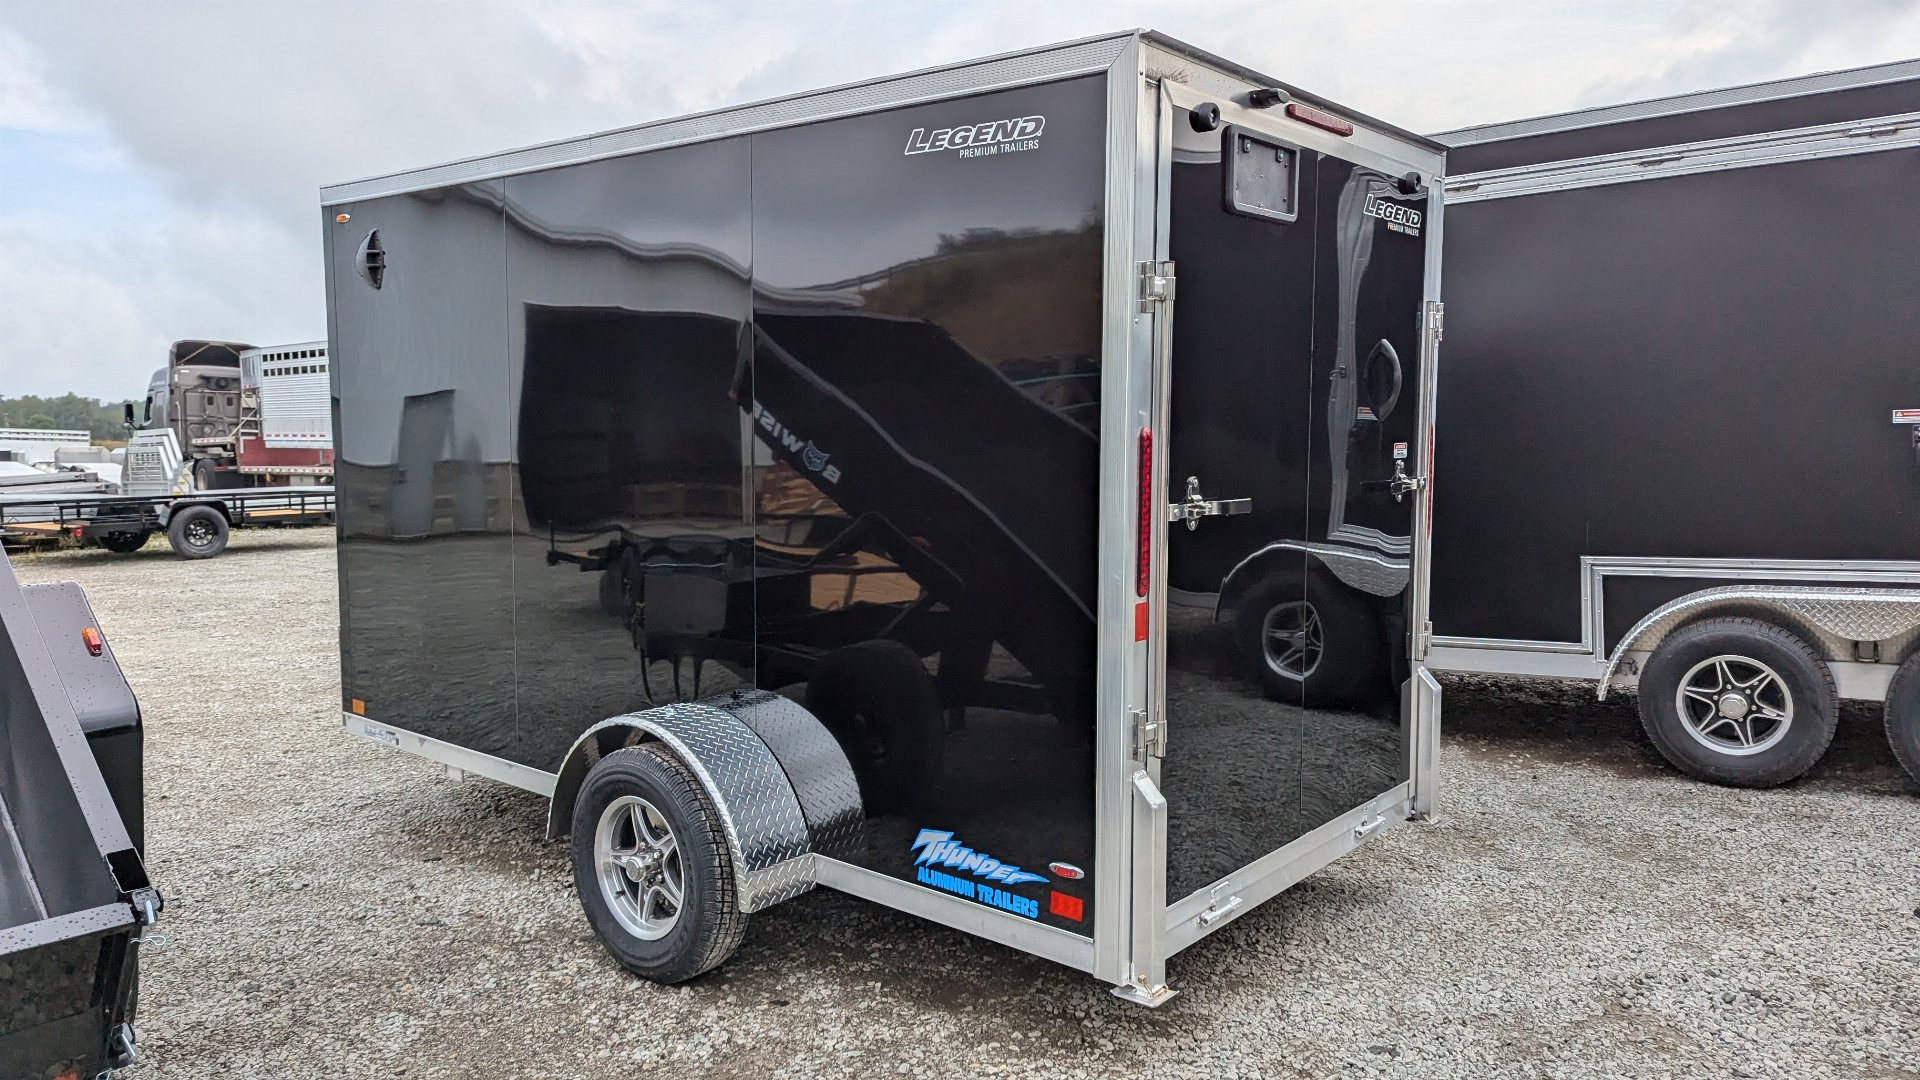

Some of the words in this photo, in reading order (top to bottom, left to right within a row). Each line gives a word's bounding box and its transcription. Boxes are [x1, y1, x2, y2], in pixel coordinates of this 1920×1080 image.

[904, 115, 1046, 155] LEGEND
[959, 145, 998, 159] PREMIUM
[1000, 139, 1039, 154] TRAILERS
[1363, 193, 1422, 228] LEGEND
[917, 866, 975, 898] ALUMINUM
[977, 884, 1039, 918] TRAILERS
